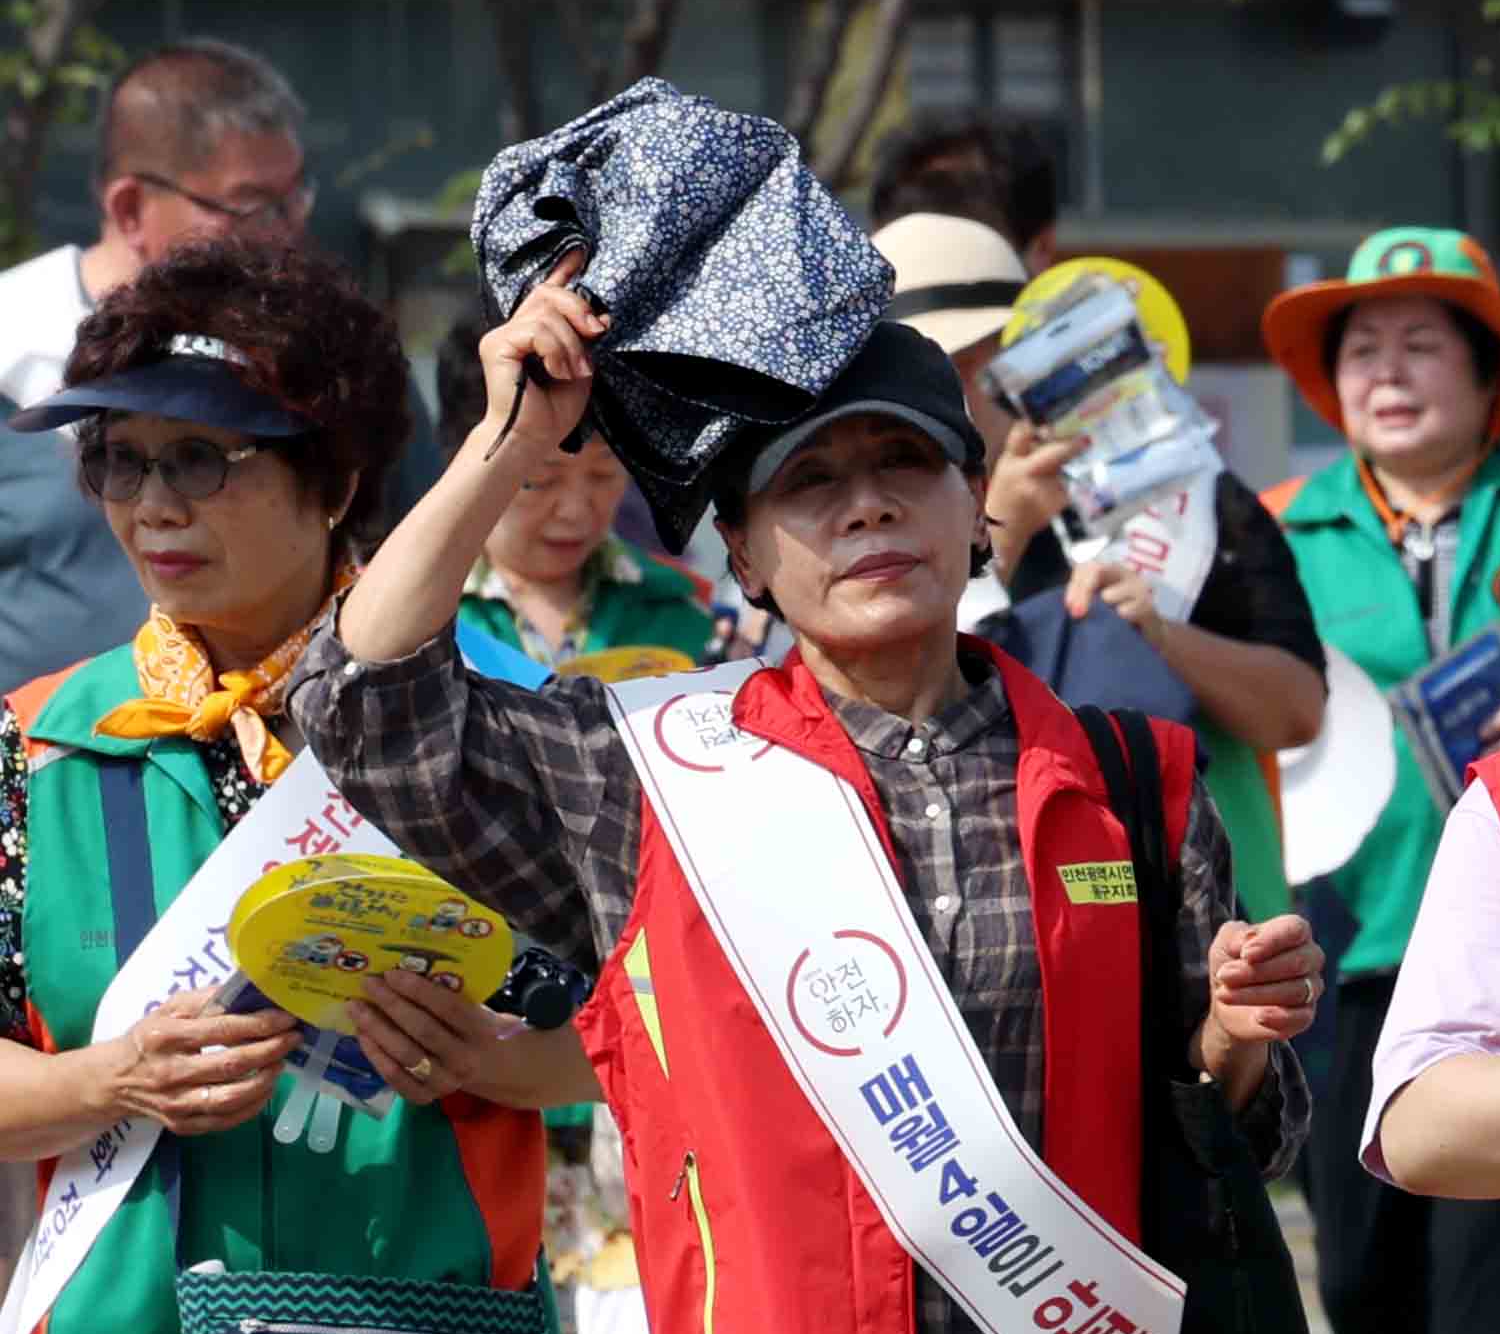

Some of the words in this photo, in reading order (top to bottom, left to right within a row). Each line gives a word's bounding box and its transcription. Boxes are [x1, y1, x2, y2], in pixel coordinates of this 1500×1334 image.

[809, 956, 867, 1004] 안전
[859, 1053, 961, 1173] 매월
[938, 1157, 1064, 1299] 4일은
